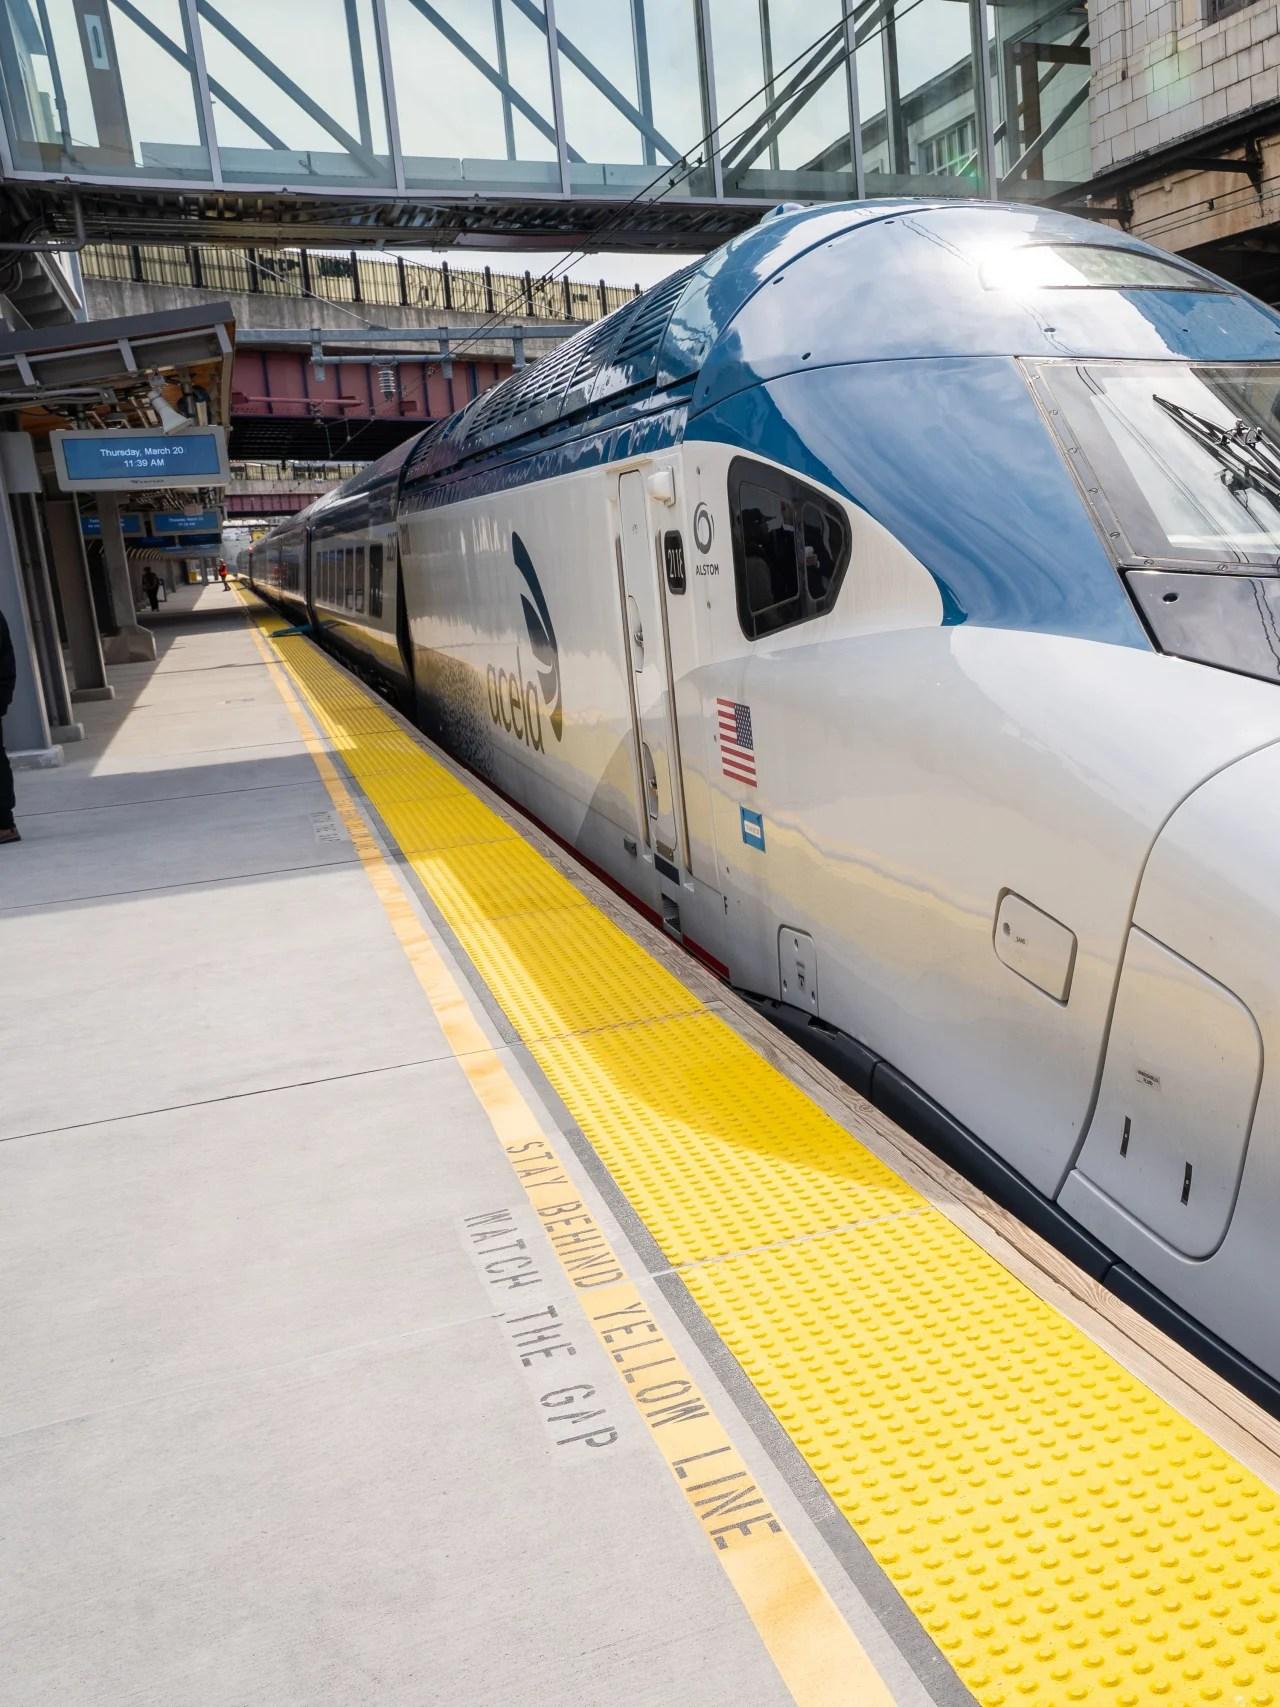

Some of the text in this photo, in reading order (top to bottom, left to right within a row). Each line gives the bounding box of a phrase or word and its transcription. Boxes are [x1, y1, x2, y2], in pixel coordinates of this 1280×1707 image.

[100, 446, 184, 458] Thursday, March 20
[123, 458, 165, 468] 11:39 AM
[695, 563, 720, 577] ALSTOM
[486, 645, 545, 755] acela
[463, 1208, 618, 1449] WATCH THE GAP
[505, 1140, 782, 1550] STAY BEHIND YELLOW LINE
